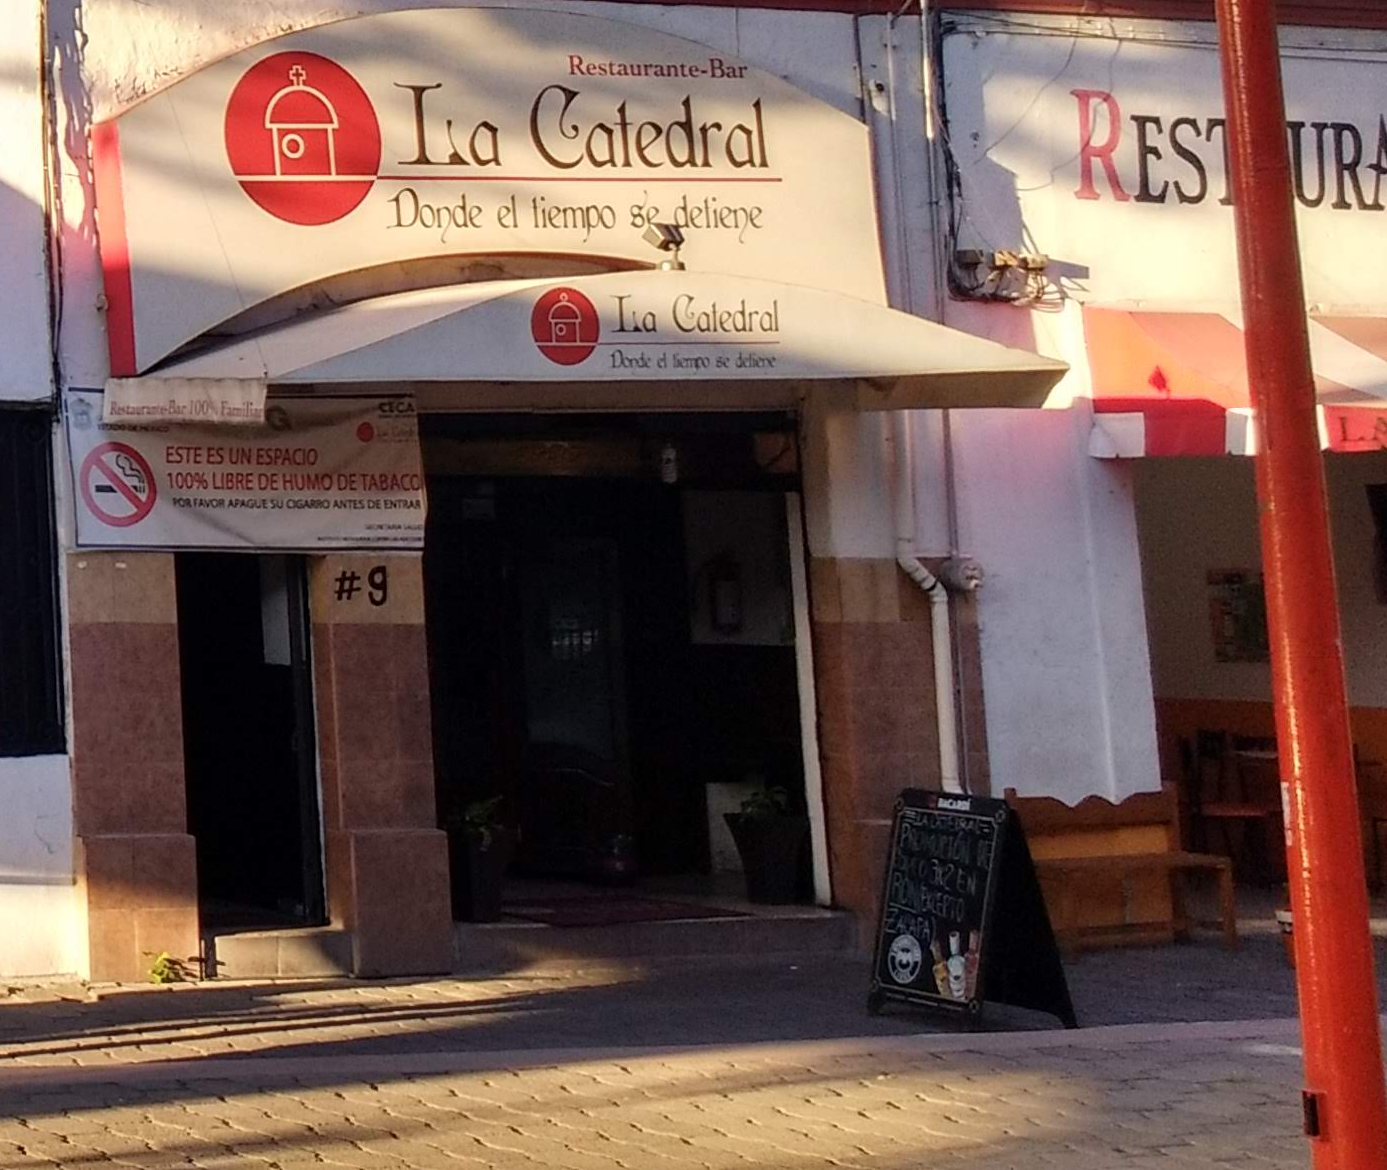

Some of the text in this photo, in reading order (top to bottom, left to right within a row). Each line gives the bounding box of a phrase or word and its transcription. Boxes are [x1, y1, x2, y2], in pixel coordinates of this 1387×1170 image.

[568, 55, 747, 80] Restaurante-Bar
[395, 82, 770, 169] La Catedral
[1070, 88, 1387, 212] RESUR
[386, 188, 764, 245] Donde el tiempo se detiene
[610, 293, 779, 333] La Catedral
[610, 351, 776, 372] Donde el tiempo se detiene
[378, 402, 415, 413] CECA
[166, 446, 318, 467] ESTE ES UN ESPACIO
[168, 472, 423, 492] 100% LIBRE DE HUMO DE TABACO
[172, 498, 421, 510] POR FAVOR APAGUE SU CIGARRO ANTES DE ENTRAR
[334, 566, 387, 606] #9
